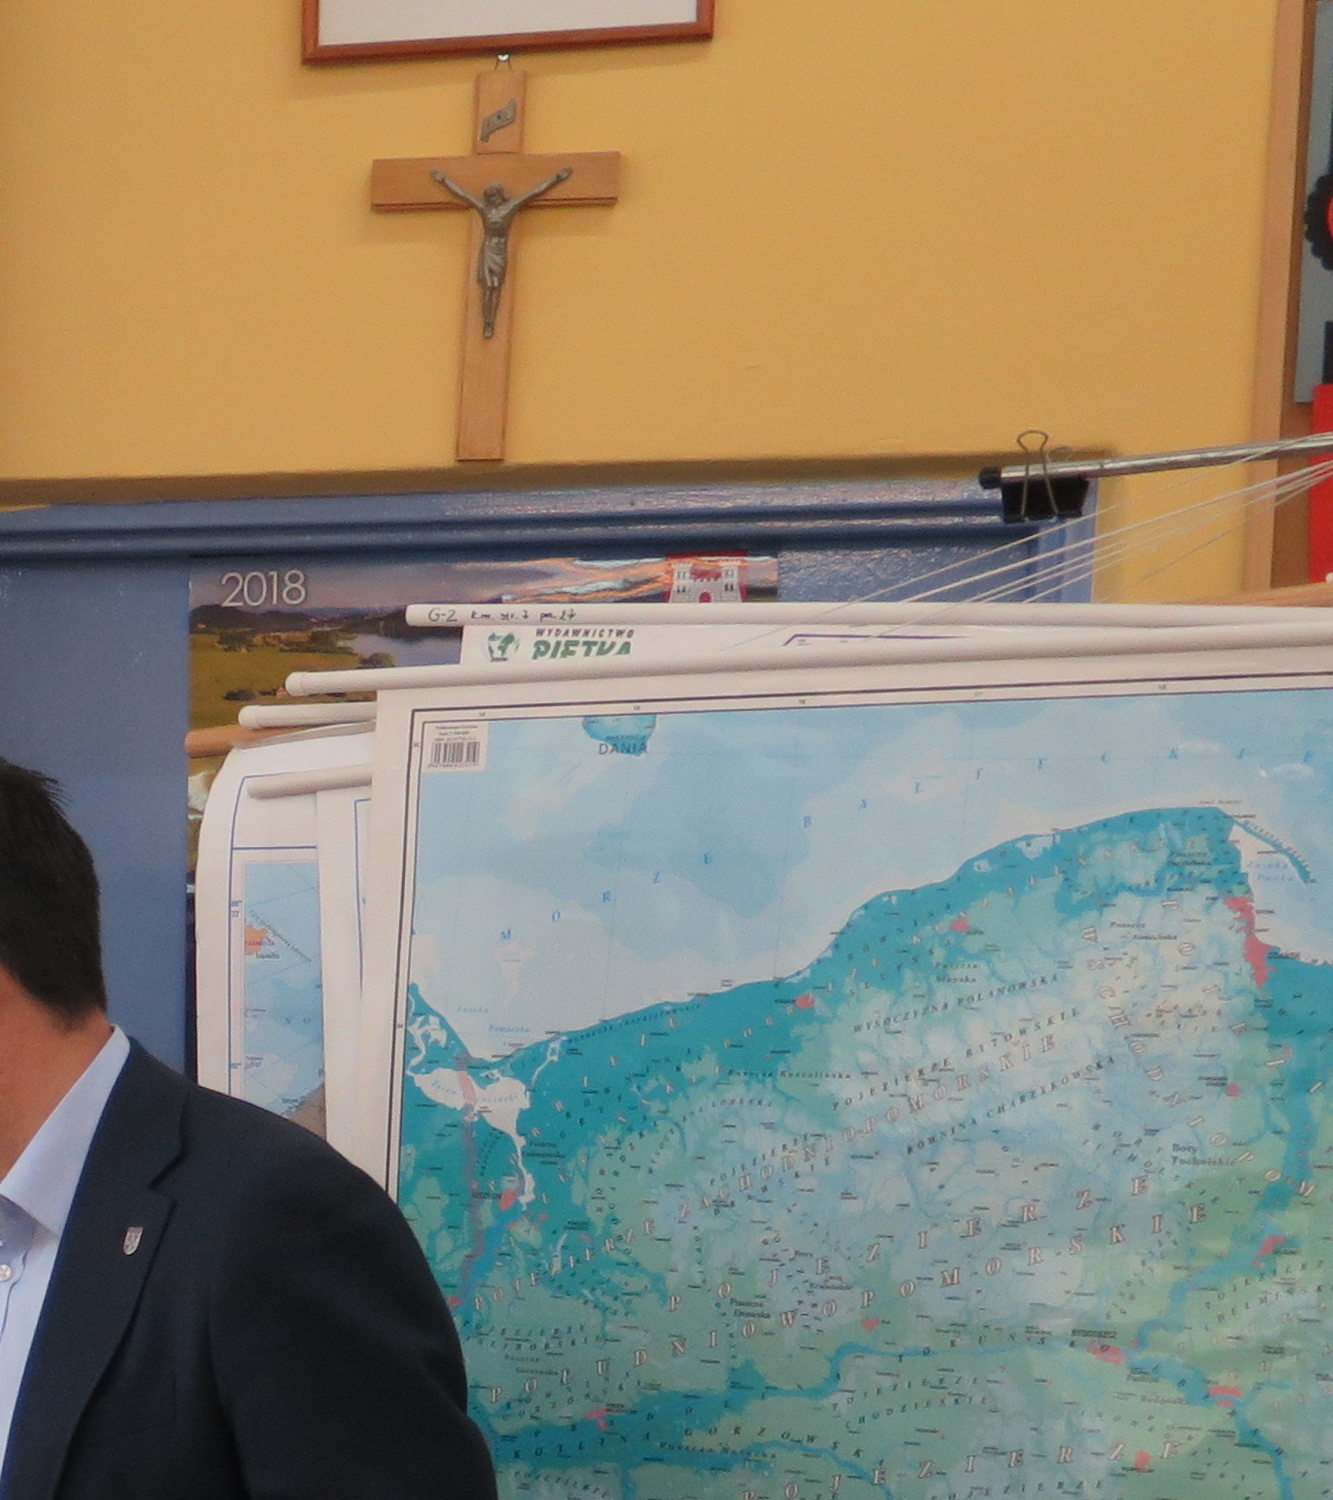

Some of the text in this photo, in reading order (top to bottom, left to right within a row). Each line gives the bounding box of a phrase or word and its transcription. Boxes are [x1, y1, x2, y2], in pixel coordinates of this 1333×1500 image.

[220, 570, 307, 608] 2018
[427, 607, 459, 623] G-2
[534, 627, 635, 638] WYDAWNICTWO
[598, 742, 648, 757] DANIA
